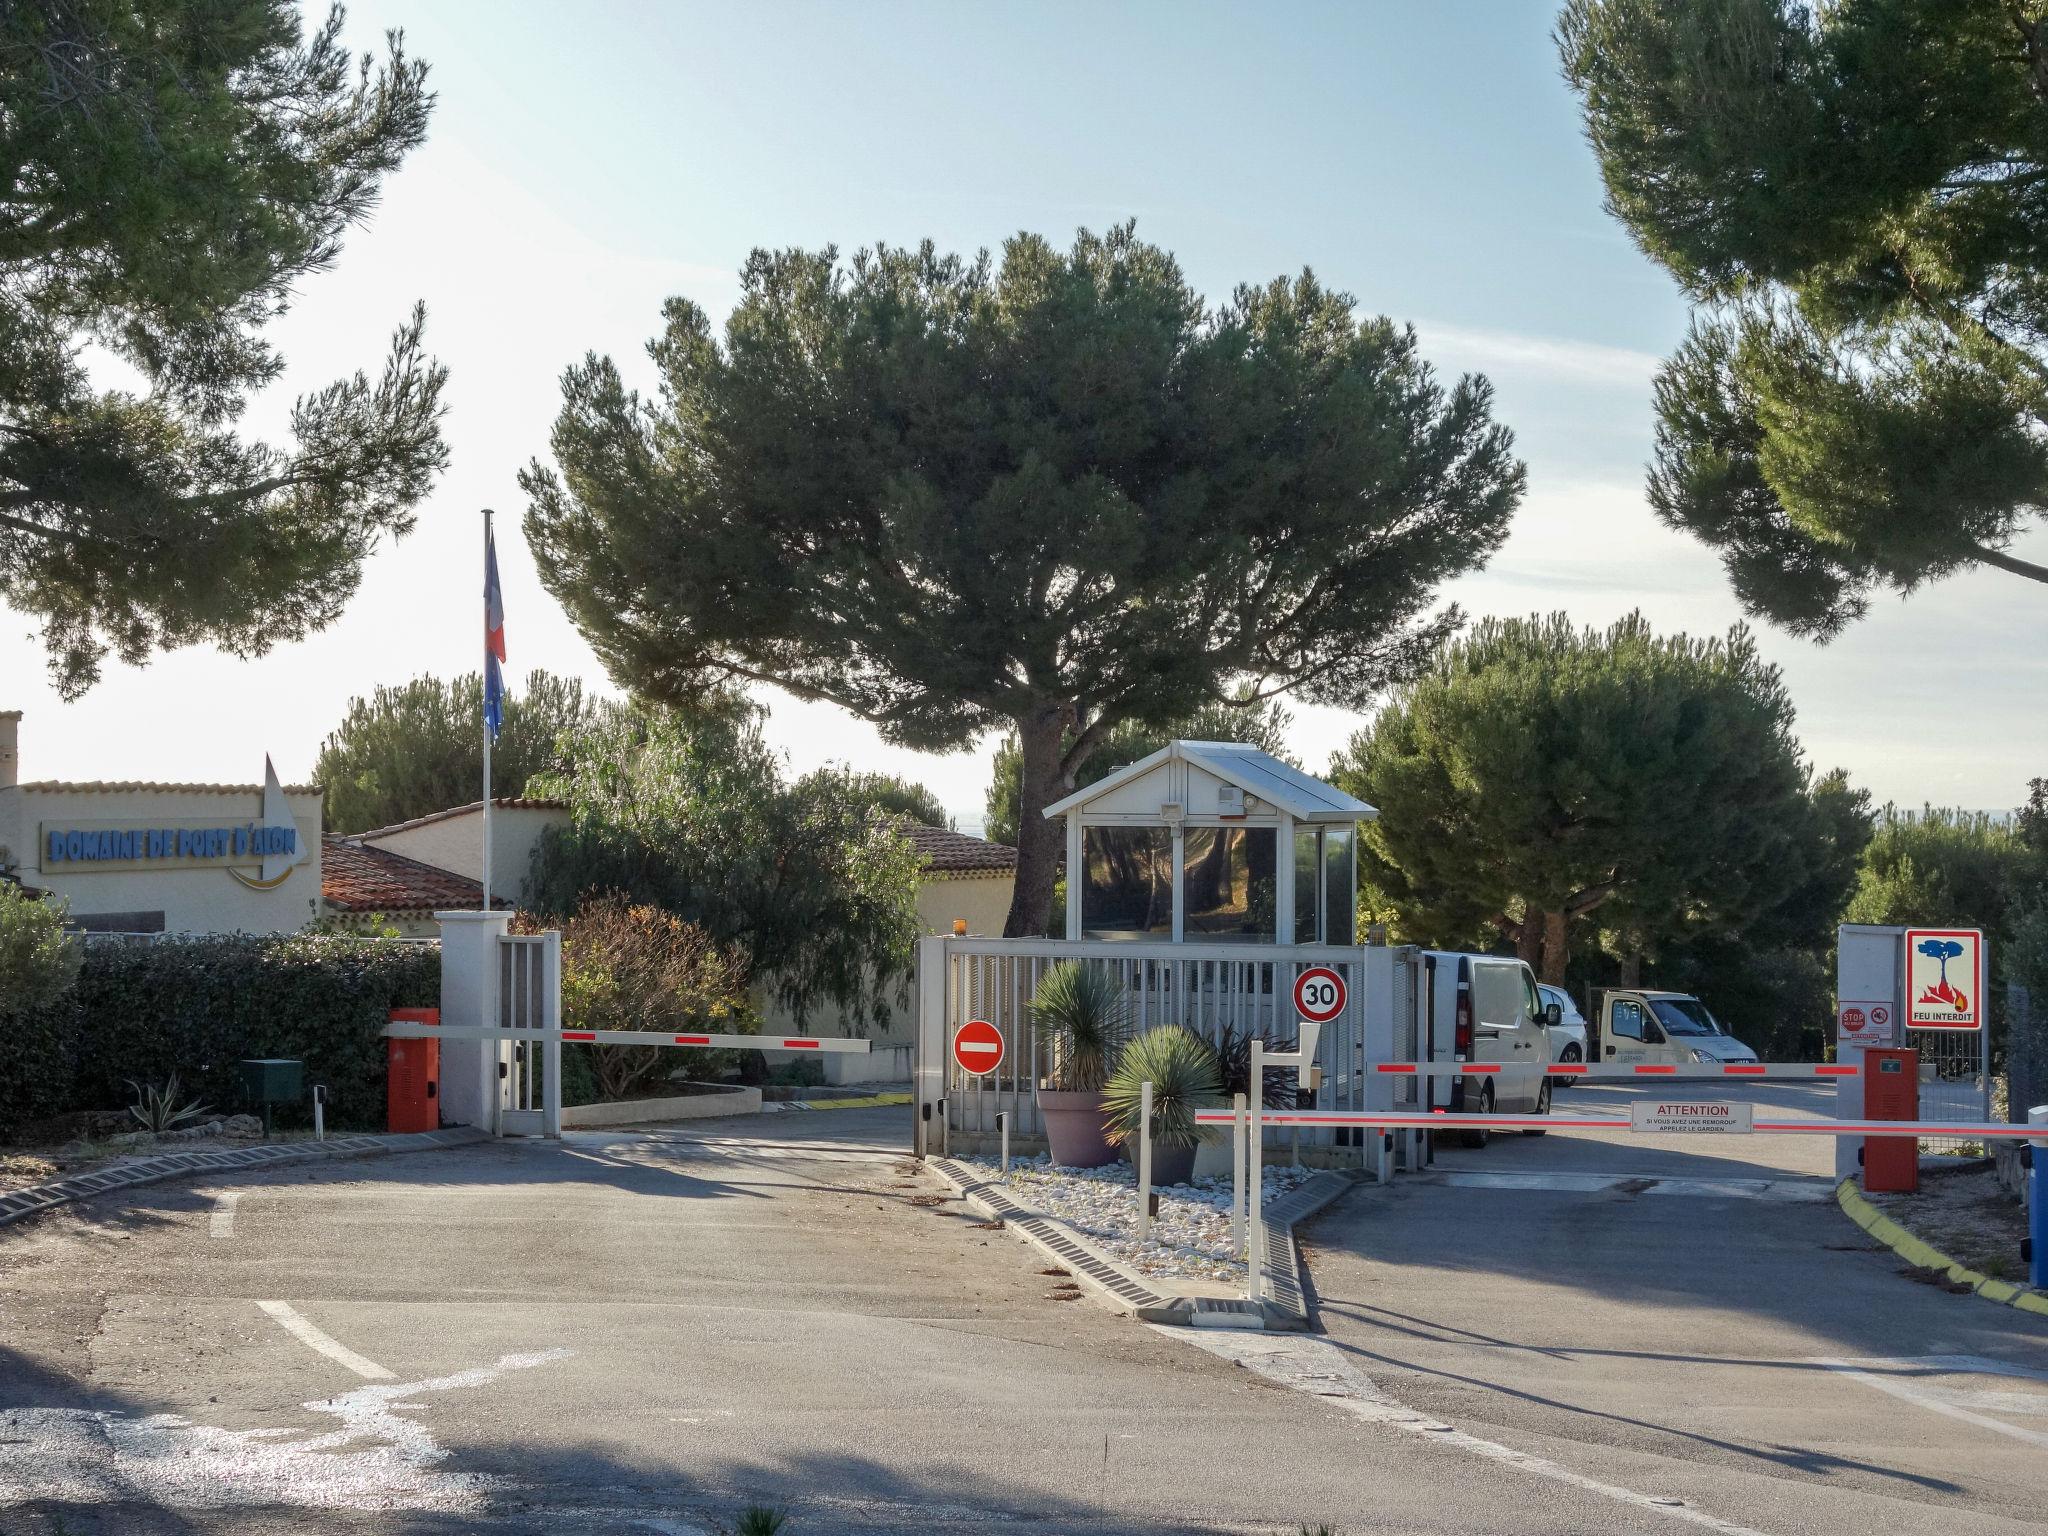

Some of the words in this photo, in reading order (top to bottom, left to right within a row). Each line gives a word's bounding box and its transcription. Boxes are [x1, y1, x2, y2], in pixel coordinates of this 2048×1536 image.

[49, 829, 144, 862] DOMAINE
[147, 828, 174, 858] DE
[178, 828, 230, 858] PORT
[234, 822, 296, 856] D'ALON
[1305, 983, 1335, 1006] 30
[1843, 1013, 1865, 1022] STOP
[1914, 1012, 1930, 1020] FEU
[1932, 1013, 1973, 1021] INTERDIT
[1657, 1105, 1729, 1116] ATTENTION
